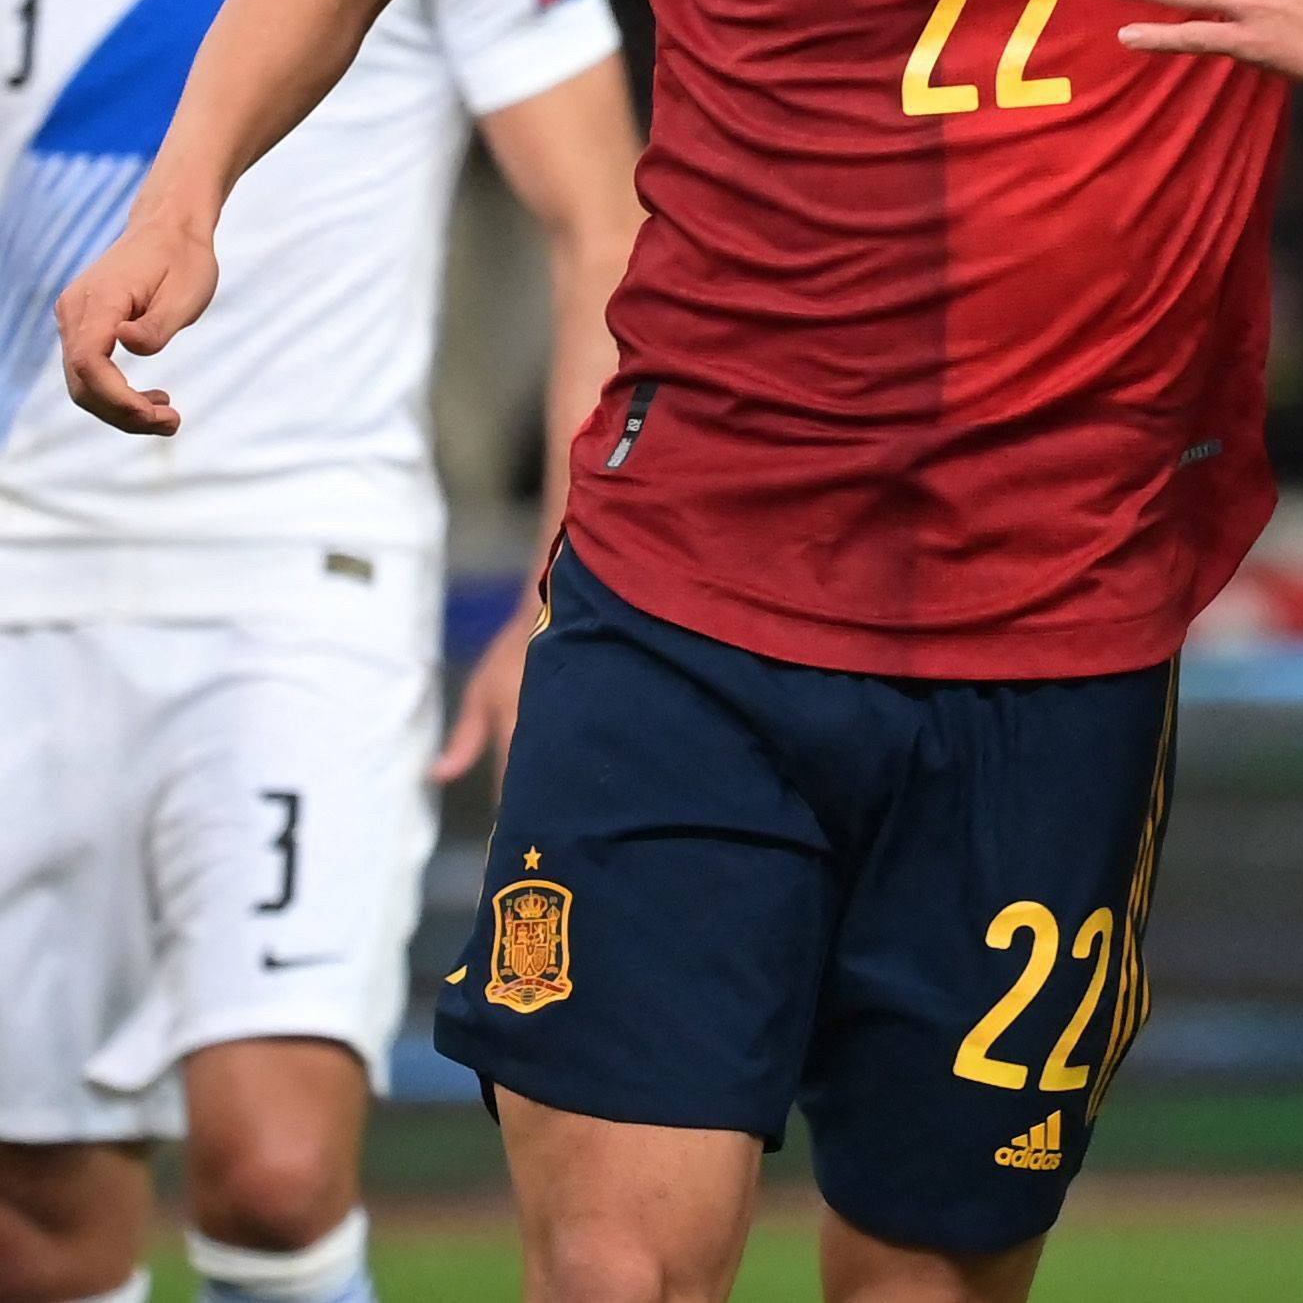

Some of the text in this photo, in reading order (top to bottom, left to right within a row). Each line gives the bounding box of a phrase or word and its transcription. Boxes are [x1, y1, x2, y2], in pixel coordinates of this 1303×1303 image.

[257, 791, 300, 913] 3
[951, 900, 1114, 1092] 22
[994, 1145, 1062, 1170] adidas
